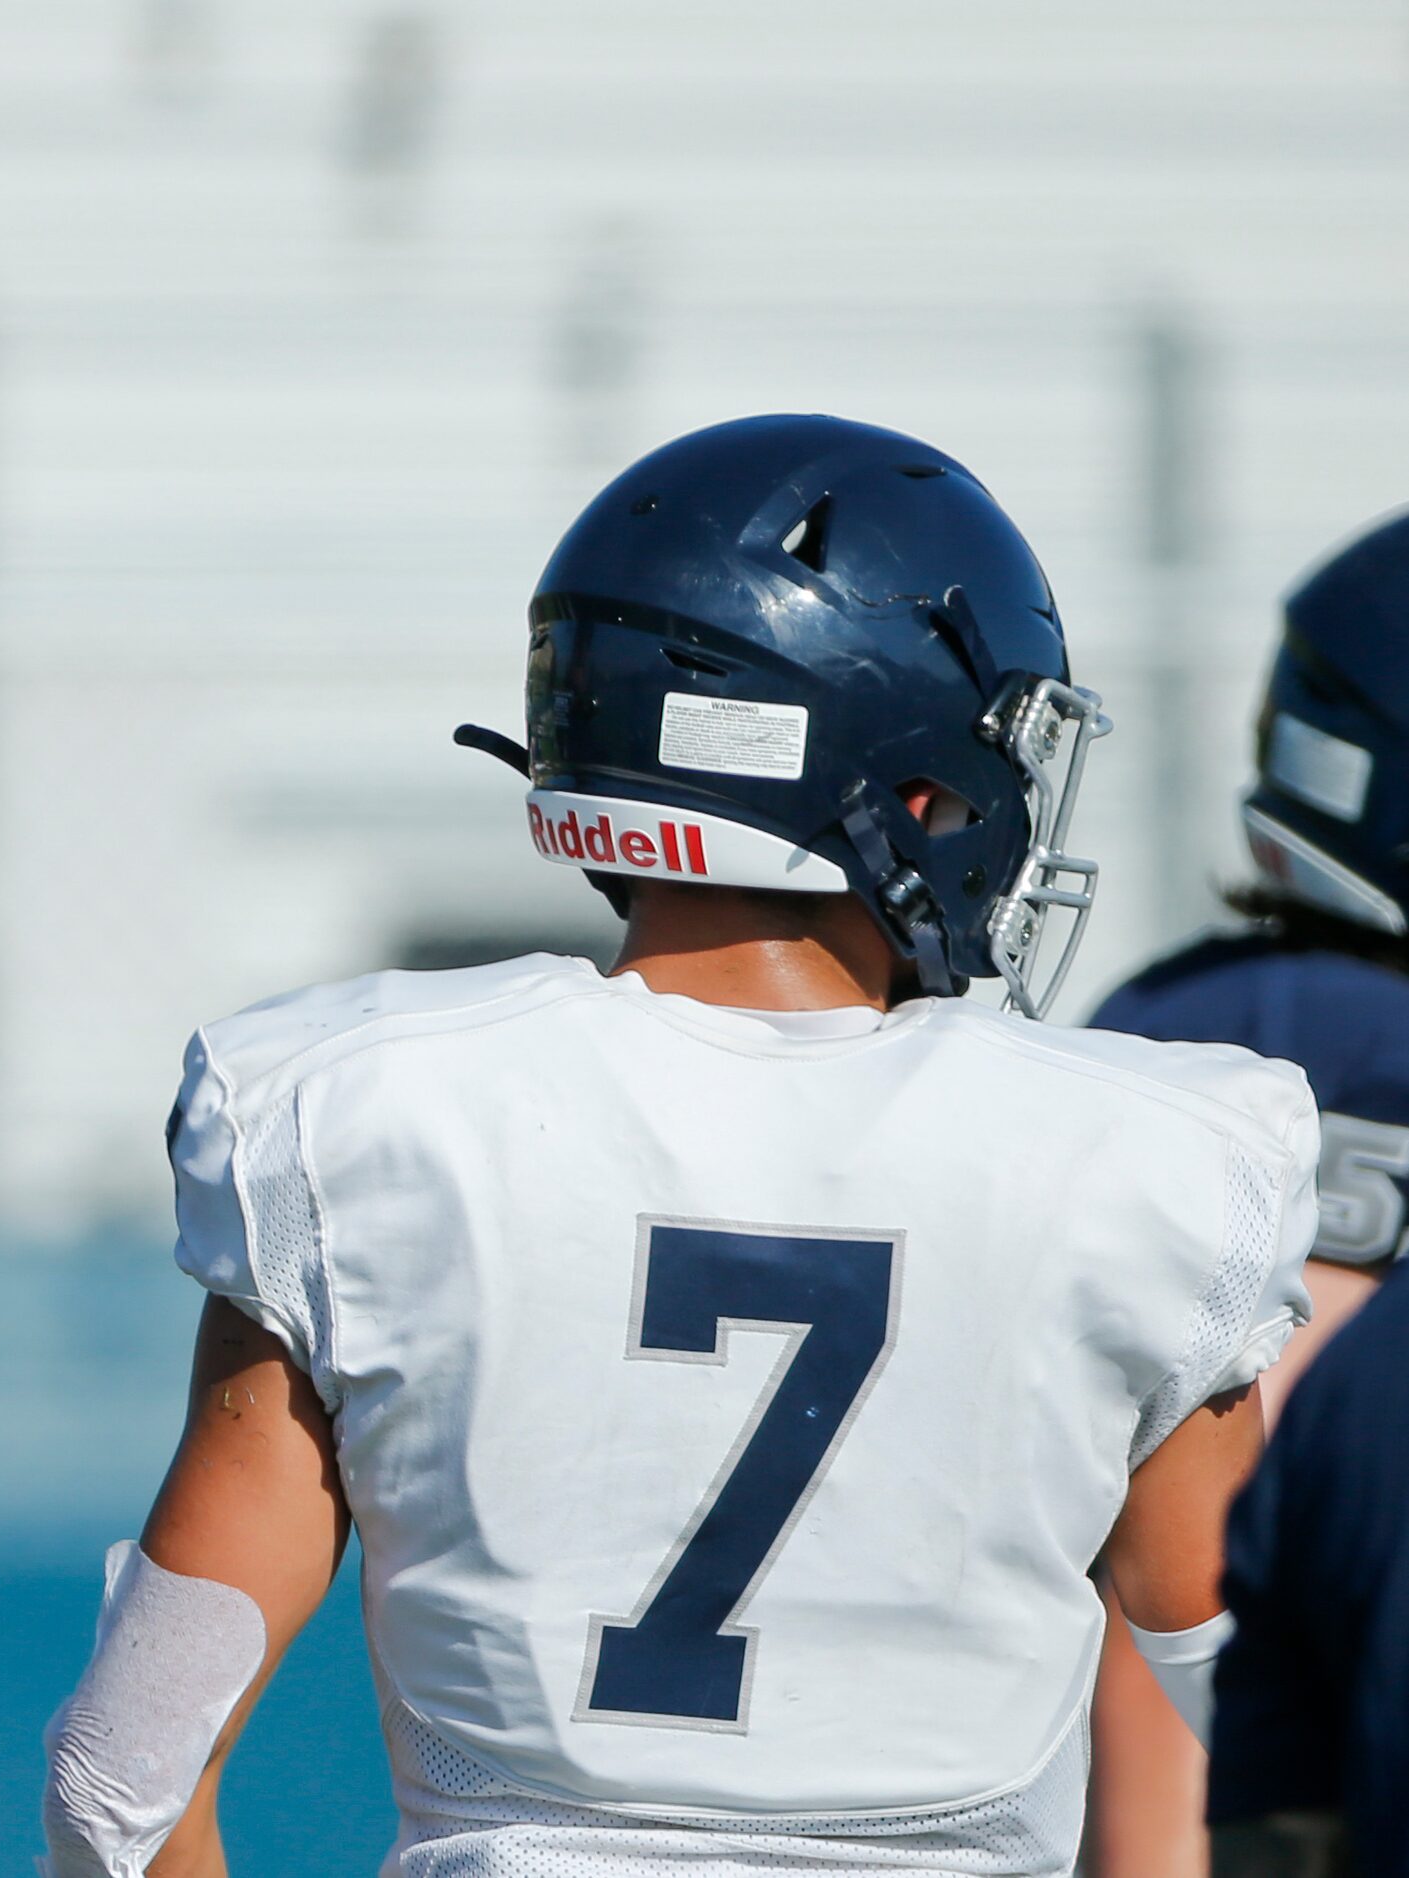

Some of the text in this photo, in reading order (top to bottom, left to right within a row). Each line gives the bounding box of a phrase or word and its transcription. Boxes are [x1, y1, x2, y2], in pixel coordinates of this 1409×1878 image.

[711, 702, 760, 714] WARNING
[528, 802, 710, 876] Riddell
[571, 1212, 907, 1736] 7
